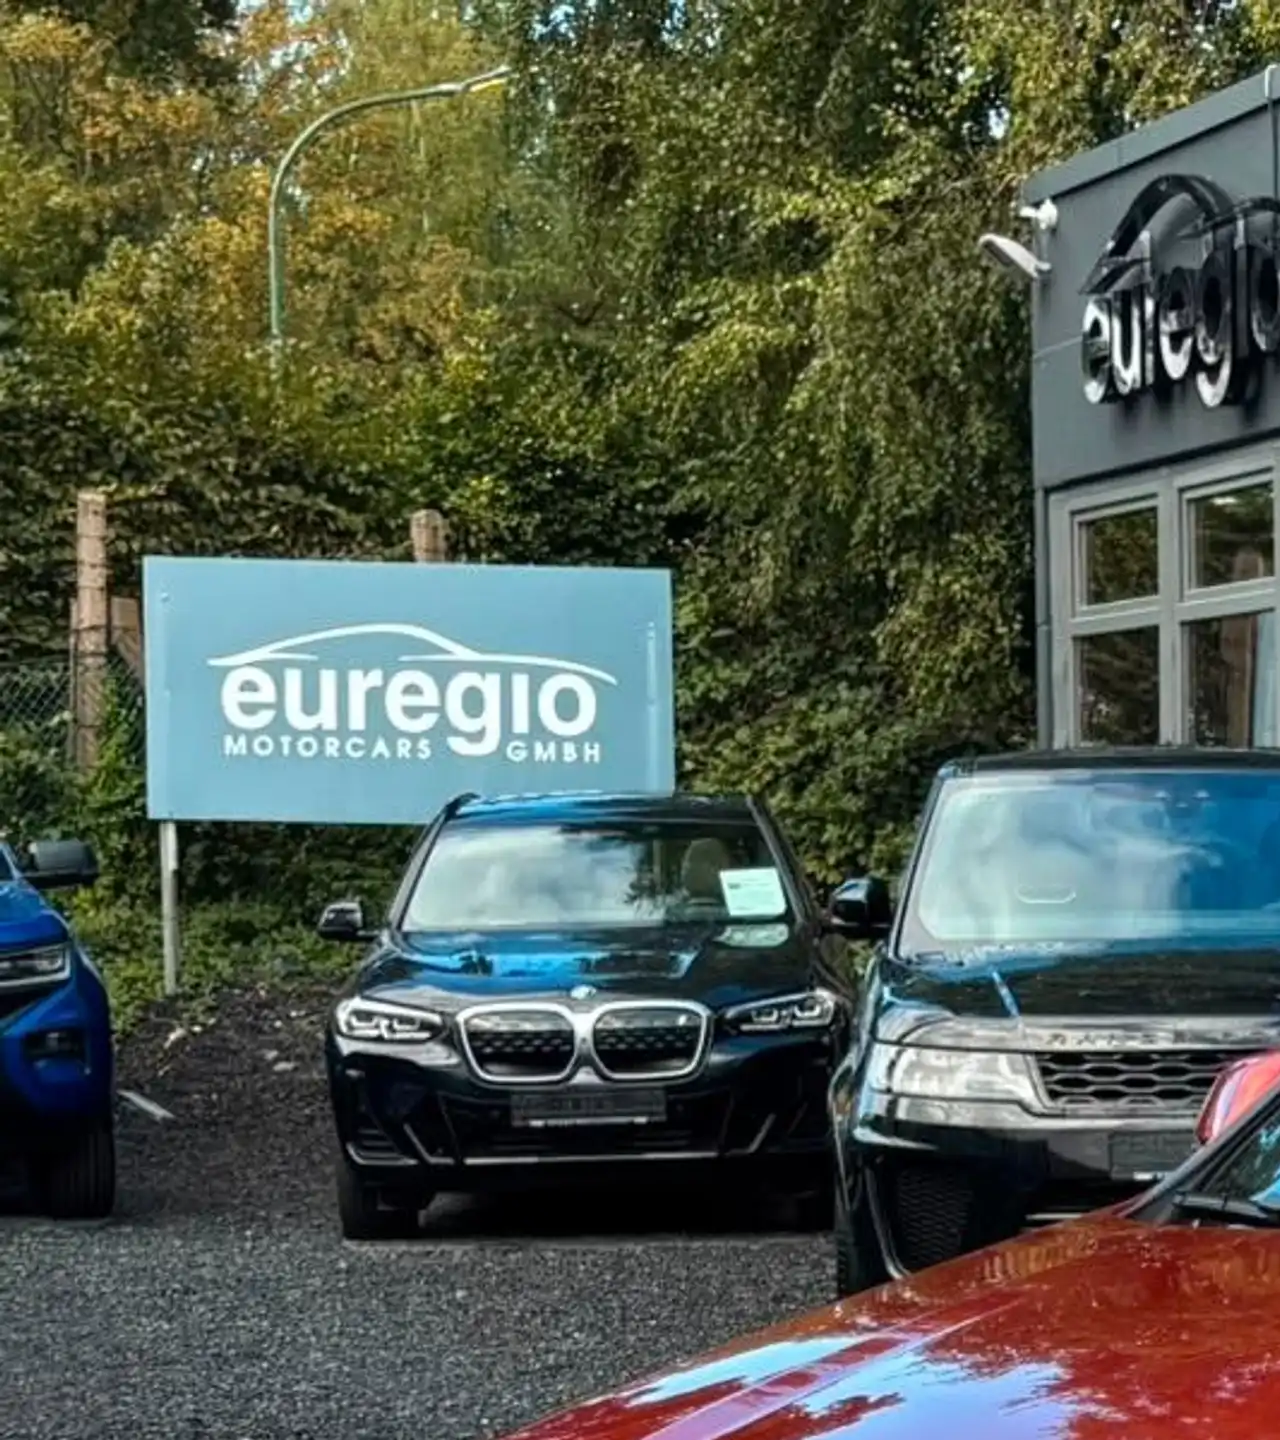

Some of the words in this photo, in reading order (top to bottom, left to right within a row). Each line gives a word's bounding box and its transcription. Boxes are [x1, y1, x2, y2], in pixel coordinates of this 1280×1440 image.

[221, 665, 597, 757] euregio
[223, 734, 432, 760] MOTORCARS
[506, 740, 601, 763] GMBH
